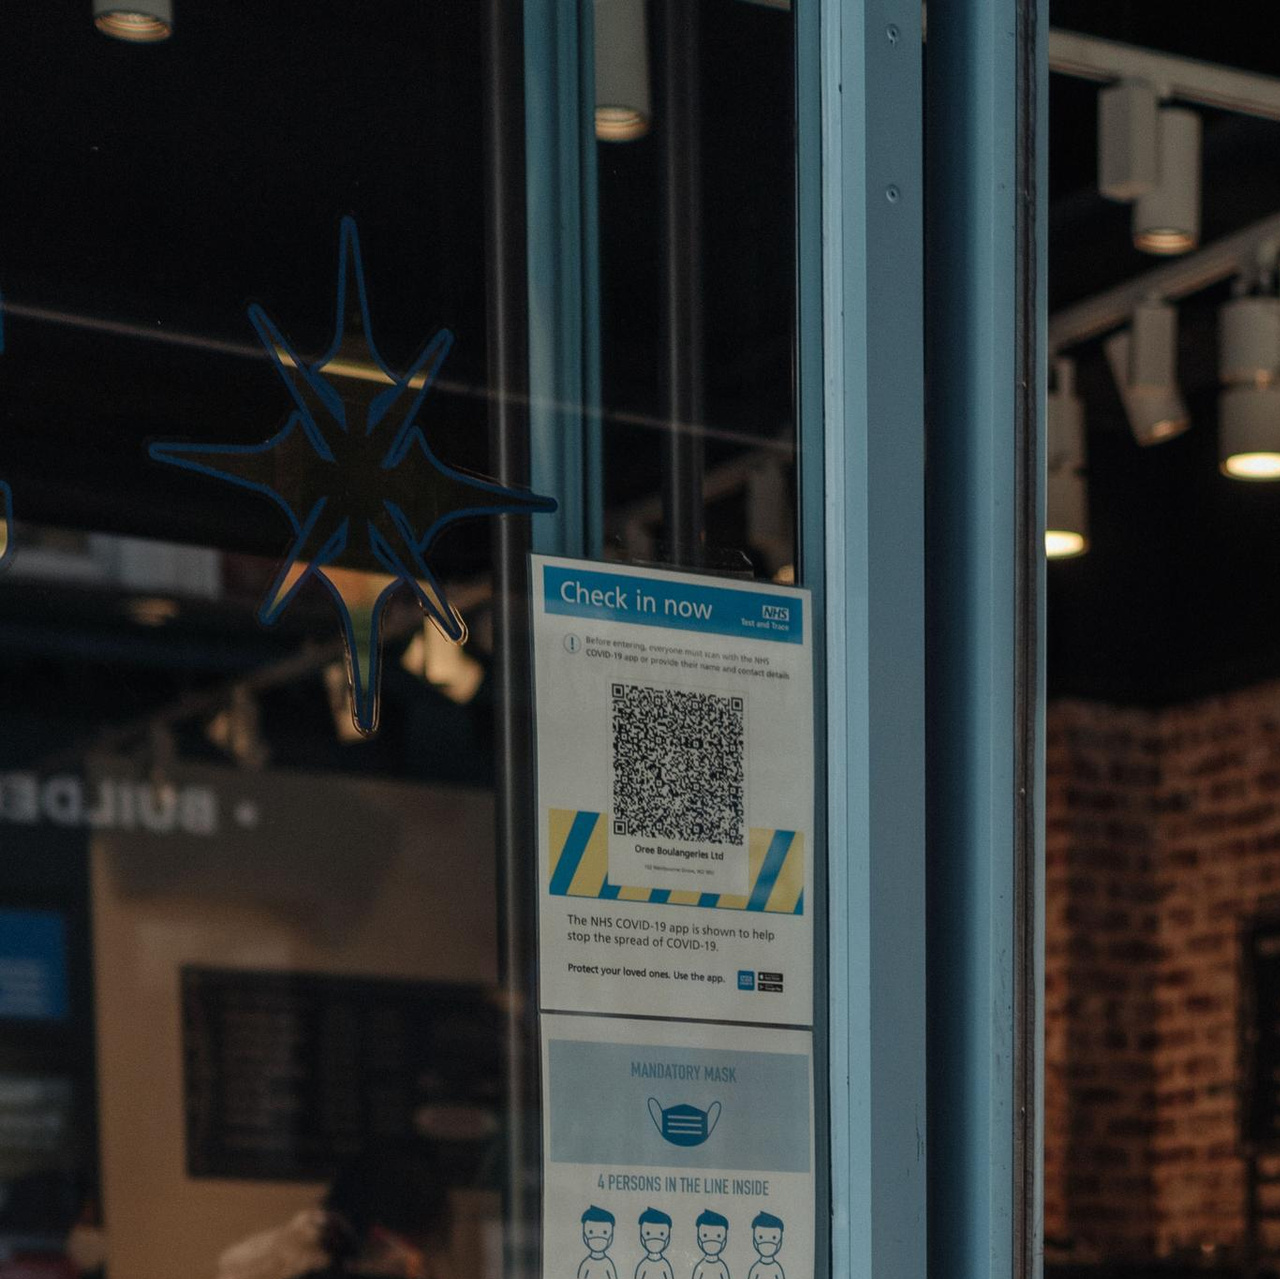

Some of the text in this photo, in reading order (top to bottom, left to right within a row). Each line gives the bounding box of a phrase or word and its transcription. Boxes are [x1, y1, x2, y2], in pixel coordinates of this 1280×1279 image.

[560, 580, 713, 620] Check in now
[741, 618, 789, 631] Test and Trace
[764, 606, 788, 620] NHS
[586, 636, 611, 646] Before
[613, 640, 647, 652] entering,
[649, 644, 683, 655] everyone
[684, 649, 703, 658] must
[722, 652, 739, 661] with
[741, 654, 753, 663] the
[755, 656, 769, 666] NHS
[586, 648, 622, 660] COVID-19
[624, 654, 638, 663] app
[651, 657, 679, 667] provide
[681, 660, 698, 669] their
[700, 663, 721, 671] name
[722, 665, 736, 674] and
[738, 667, 765, 677] contact
[766, 669, 790, 680] details
[635, 844, 724, 861] Oree Boulangeries Ltd
[567, 914, 775, 943] The NHS COVID-19 app is shown to help
[567, 932, 719, 952] stop the spread of COVID-19.
[568, 963, 726, 985] Protect your loved ones. Use the app.
[631, 1061, 737, 1084] MANDATORY MASK
[597, 1173, 770, 1197] 4 PERSONS IN THE LINE INSIDE
